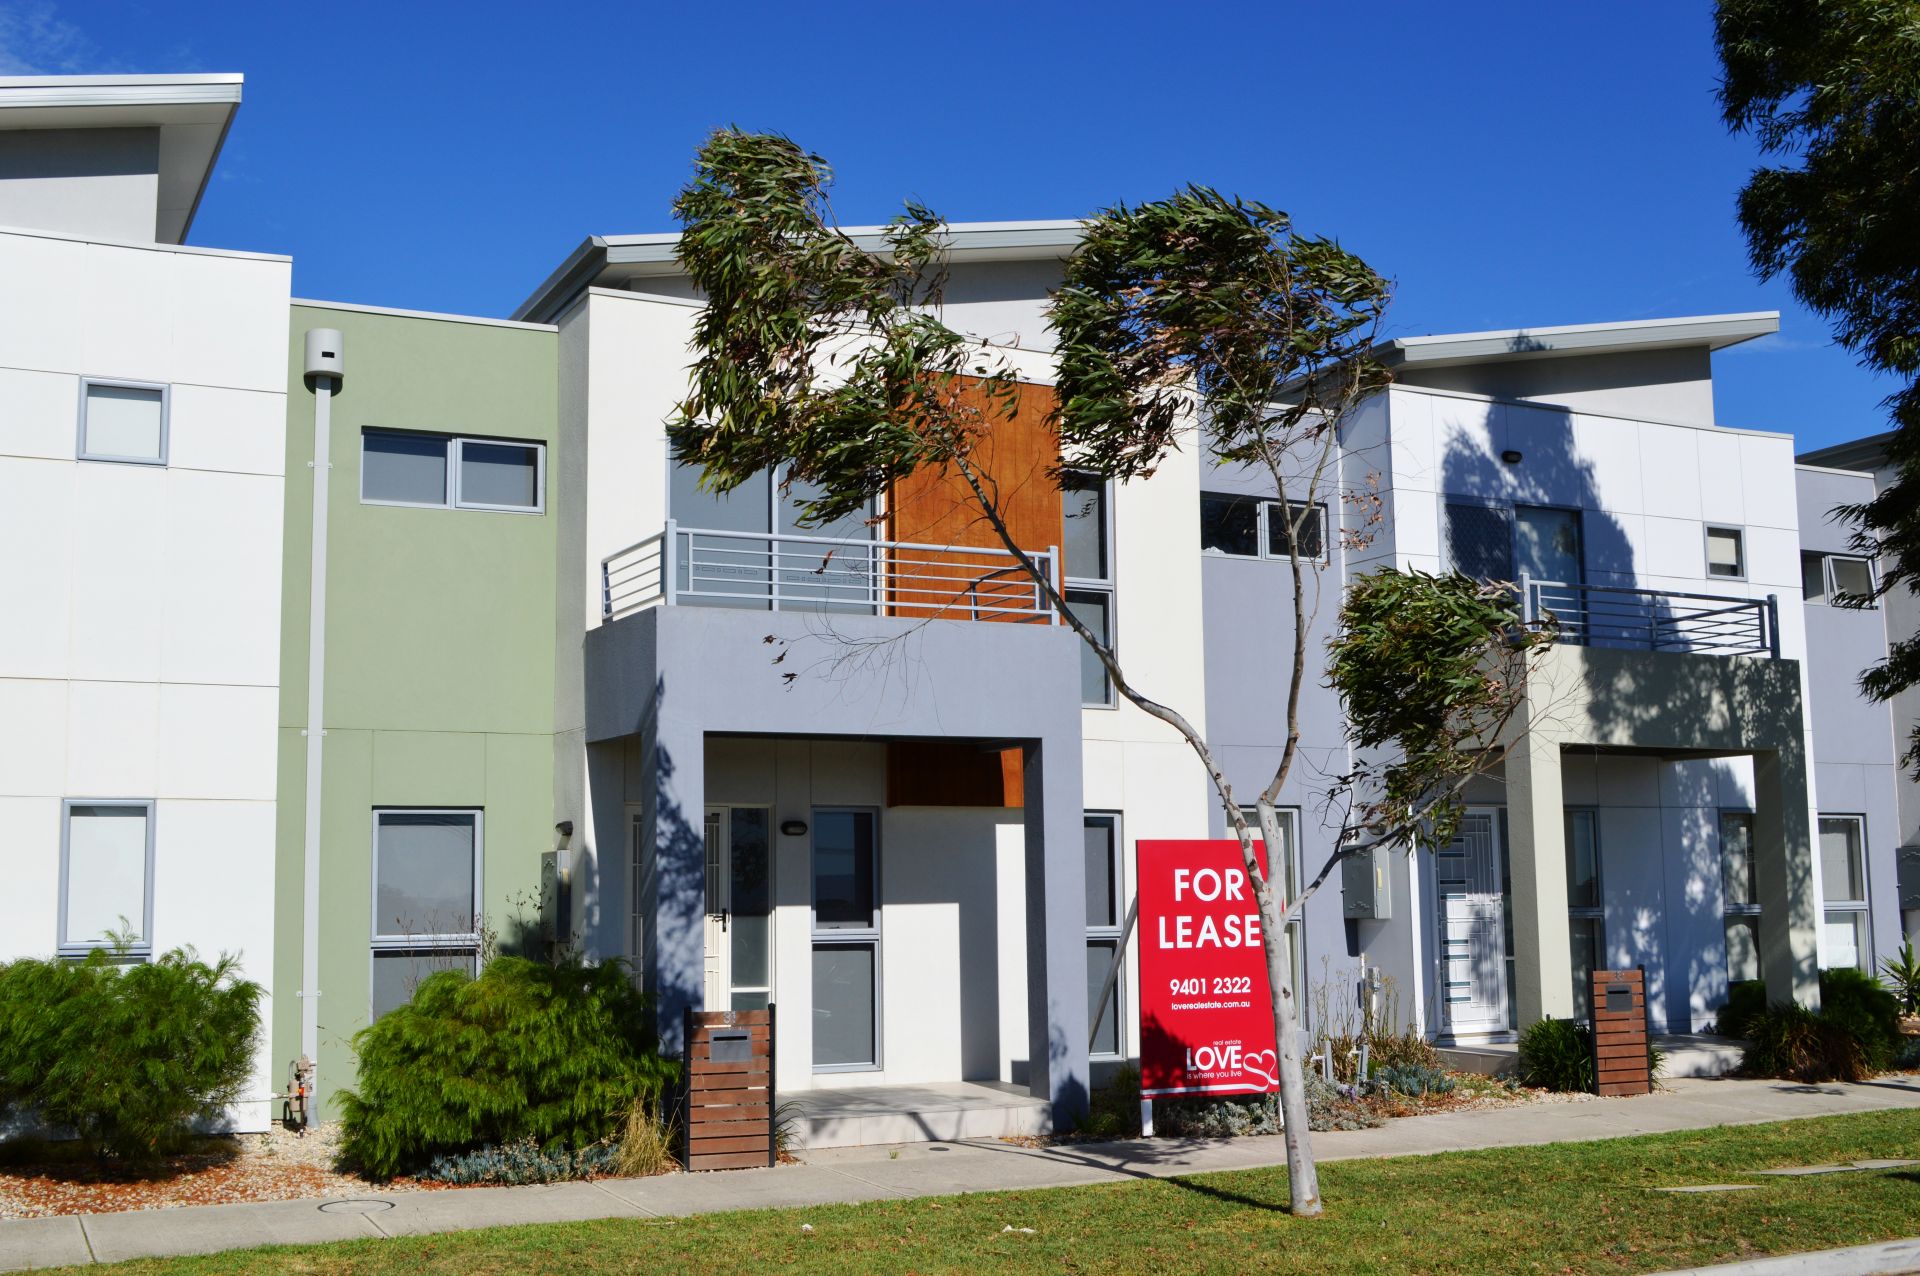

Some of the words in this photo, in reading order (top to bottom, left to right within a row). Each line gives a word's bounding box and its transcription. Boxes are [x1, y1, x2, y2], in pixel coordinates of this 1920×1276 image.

[1174, 868, 1244, 902] FOR
[1159, 914, 1261, 949] LEASE
[1169, 978, 1207, 996] 9401
[1213, 976, 1251, 994] 2322
[1171, 1001, 1250, 1010] loverealestate.com.au
[1186, 1045, 1242, 1071] LOVE
